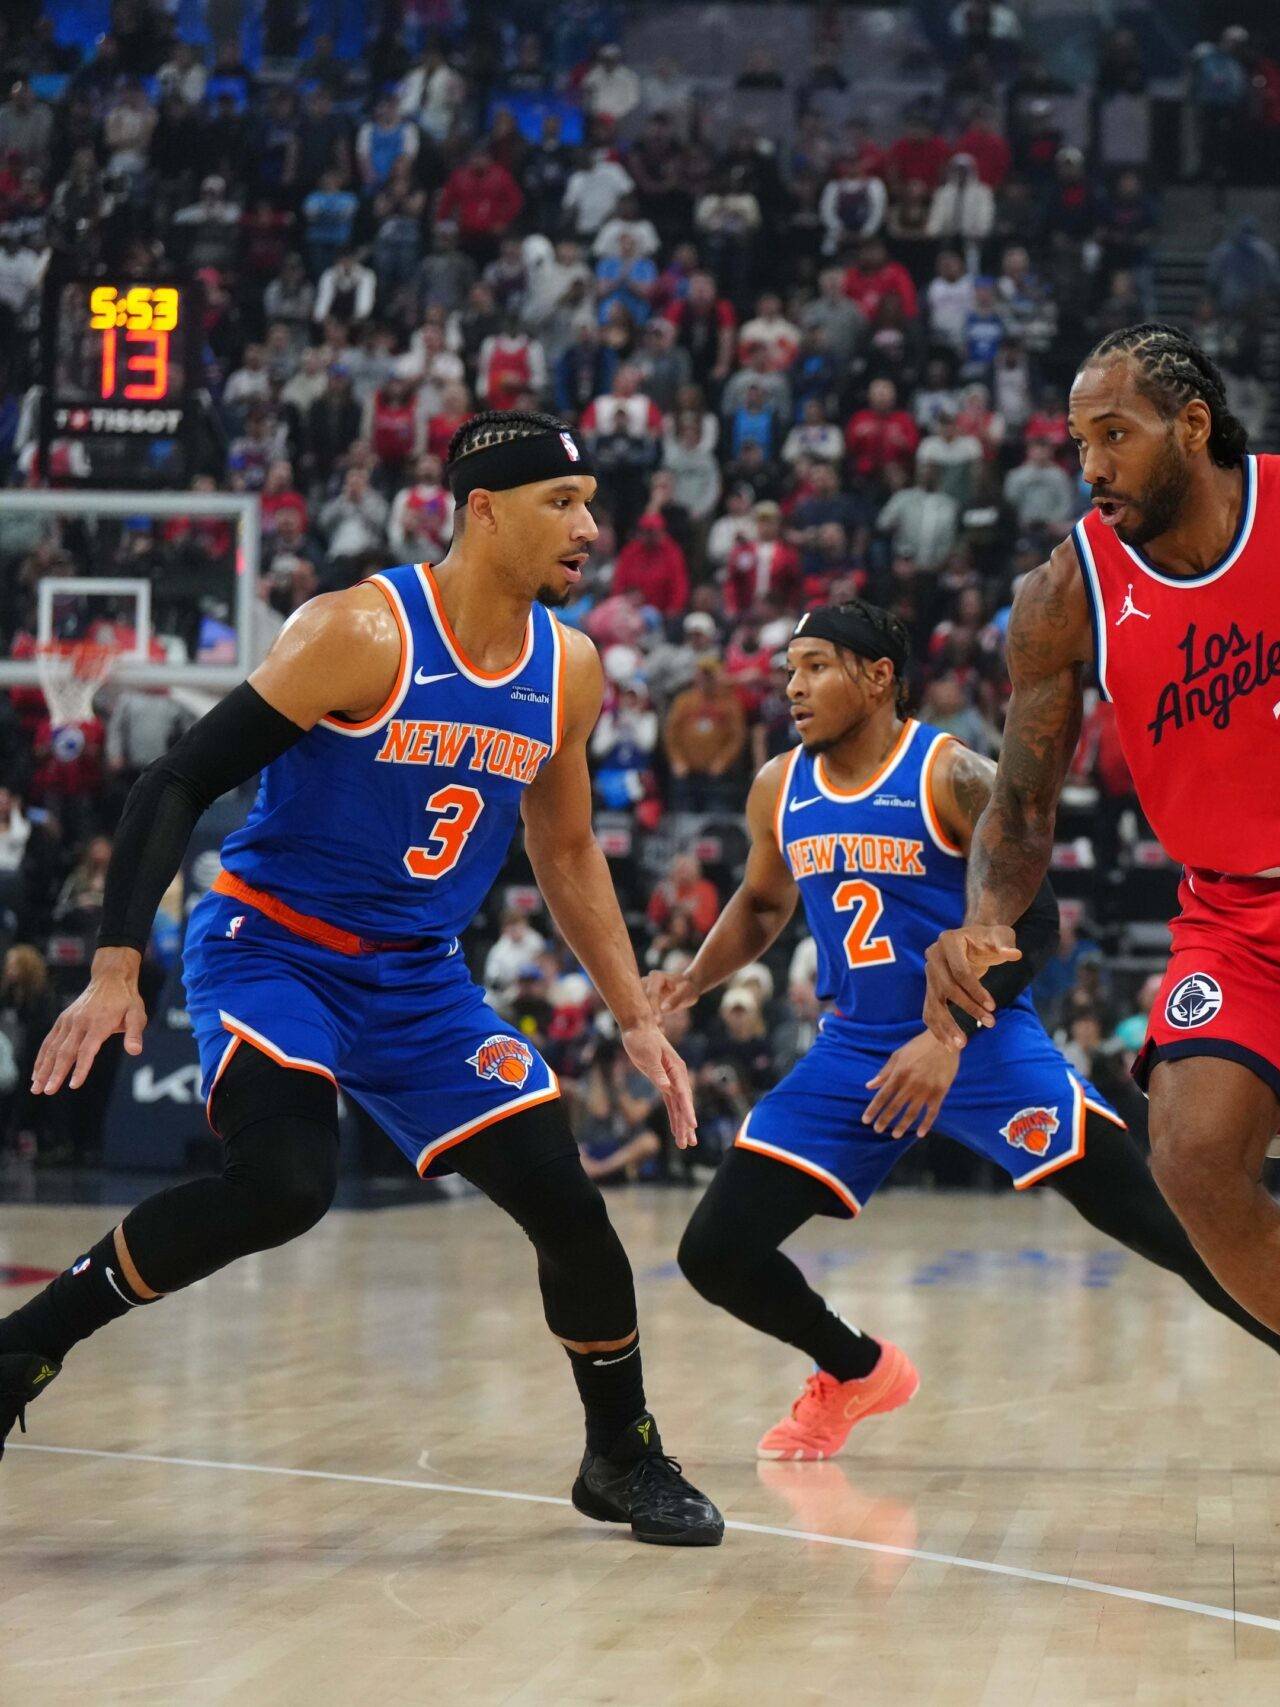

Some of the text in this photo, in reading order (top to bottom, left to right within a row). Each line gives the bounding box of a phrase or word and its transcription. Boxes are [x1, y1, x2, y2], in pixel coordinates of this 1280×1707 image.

[90, 286, 179, 331] 5:53
[101, 330, 169, 400] 13
[1177, 622, 1252, 684] Los
[511, 691, 550, 704] abu dhabi
[375, 719, 551, 784] NEW YORK
[403, 784, 485, 880] 3
[787, 833, 926, 880] NEW YORK
[832, 879, 896, 969] 2
